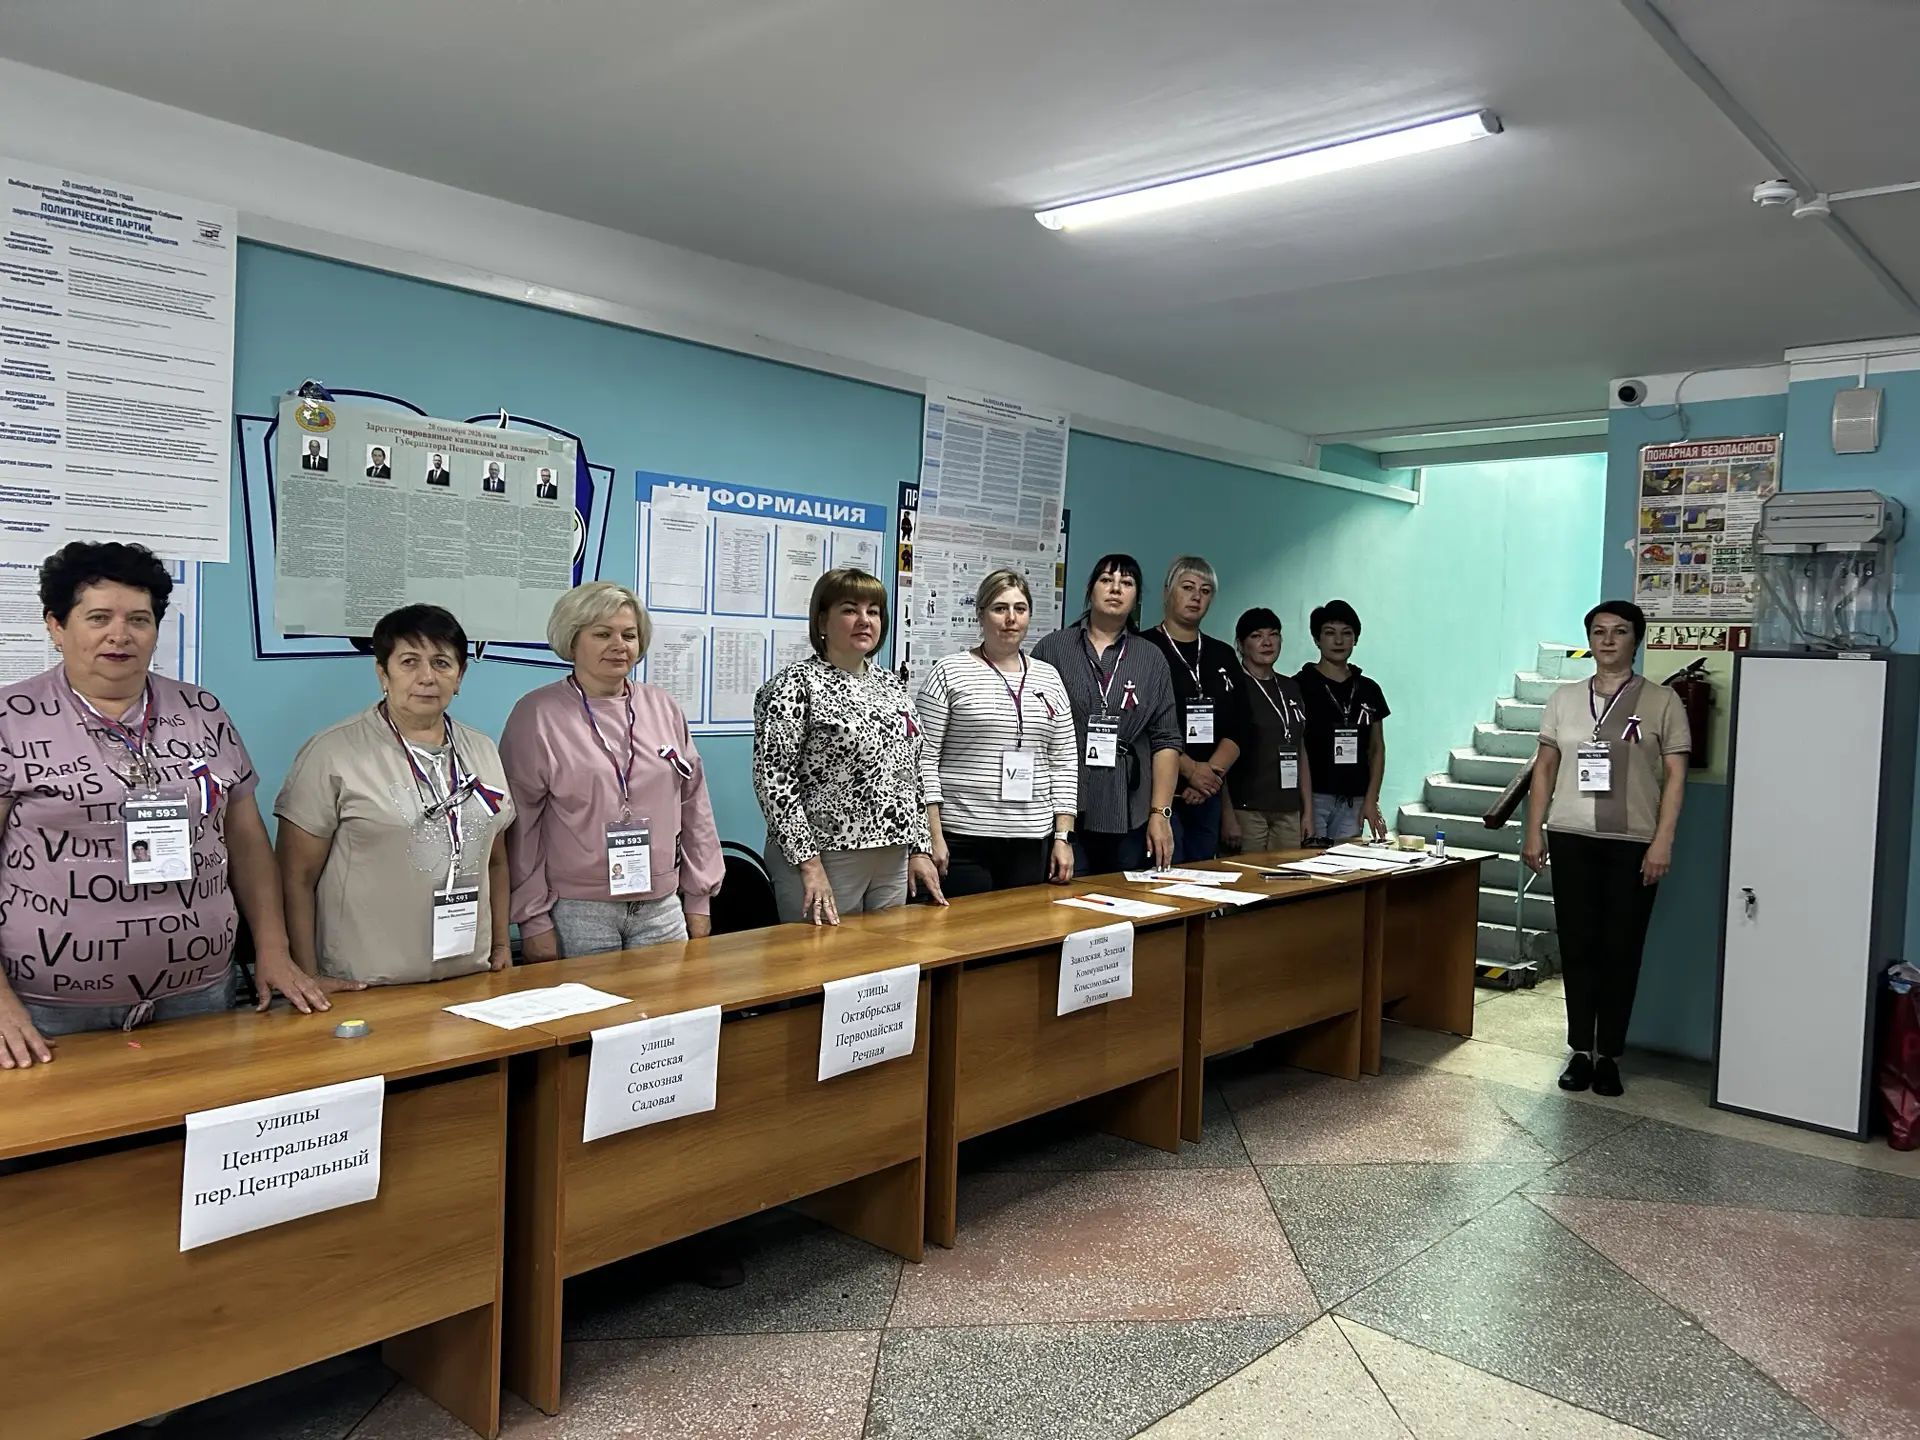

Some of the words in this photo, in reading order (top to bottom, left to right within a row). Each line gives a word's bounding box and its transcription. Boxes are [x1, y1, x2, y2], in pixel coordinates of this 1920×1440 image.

[40, 202, 115, 226] ПОЛИТИЧЕСКИЕ
[115, 218, 154, 235] ПАРТИИ,
[365, 421, 453, 442] Зарегистрированные
[454, 435, 498, 449] кандидаты
[394, 435, 448, 452] Губернатора
[448, 443, 495, 457] Пензенской
[495, 450, 526, 462] области
[1646, 447, 1699, 461] ПОЖАРНАЯ
[1701, 440, 1774, 458] БЕЗОПАСНОСТЬ
[24, 755, 92, 784] PARIS
[137, 809, 153, 819] №
[156, 808, 178, 818] 593
[37, 827, 117, 863] VUIT
[627, 836, 642, 845] 593
[10, 883, 69, 918] TTON
[117, 911, 201, 939] TTON
[38, 928, 127, 967] VUIT
[168, 917, 234, 964] LOUIS
[1089, 936, 1109, 948] улицы
[1103, 945, 1126, 958] Зеленая
[1075, 961, 1119, 979] Коммунальная
[53, 974, 114, 992] PARIS
[128, 965, 210, 1000] VUIT
[857, 984, 889, 1003] улицы
[1073, 975, 1120, 993] Комсомольская
[1083, 991, 1109, 1004] Луговая
[841, 1001, 902, 1025] Октябрьская
[835, 1021, 904, 1048] Первомайская
[641, 1037, 676, 1056] улицы
[851, 1046, 885, 1063] Речная
[630, 1054, 684, 1075] Советская
[627, 1073, 684, 1094] Совхозная
[631, 1094, 676, 1112] Садовая
[256, 1108, 321, 1138] улицы
[222, 1129, 350, 1172] Центральная
[194, 1149, 370, 1206] пер.Центральный
